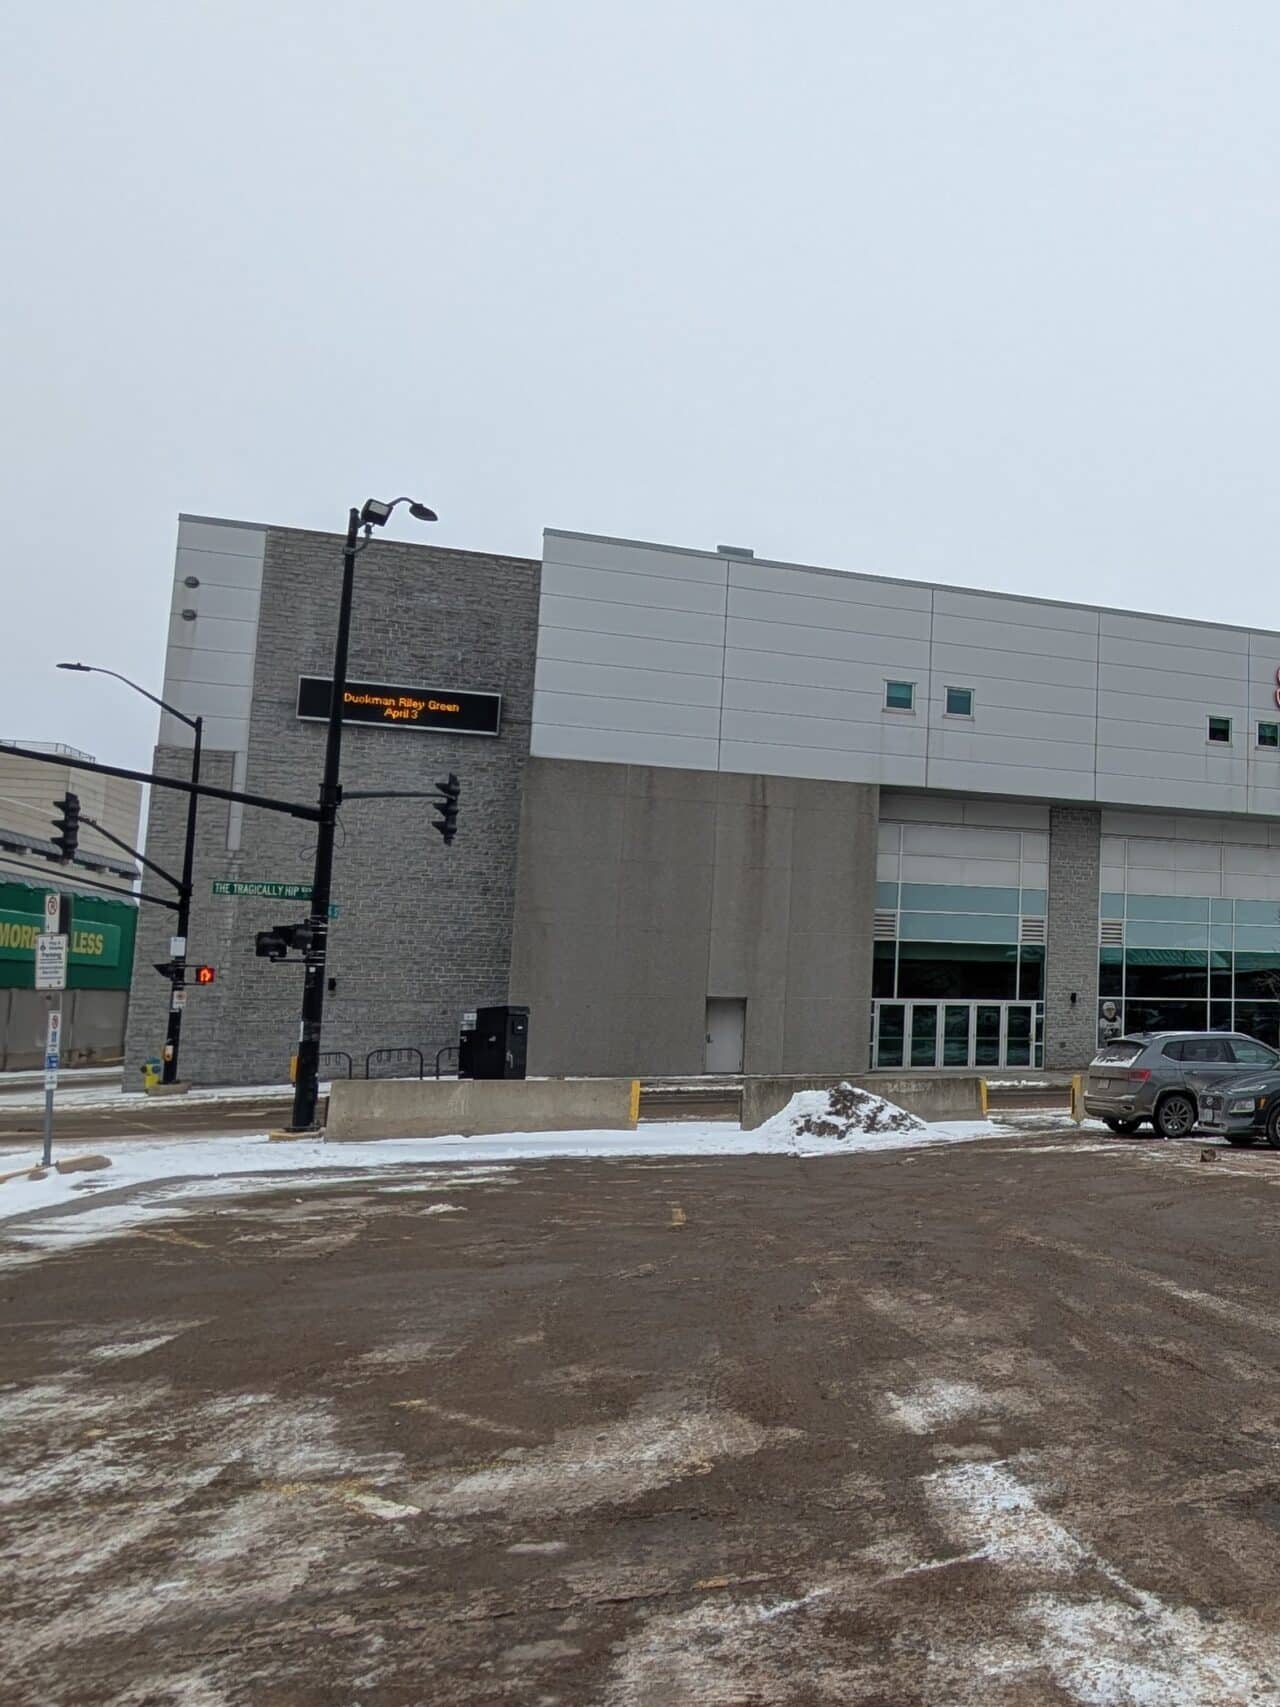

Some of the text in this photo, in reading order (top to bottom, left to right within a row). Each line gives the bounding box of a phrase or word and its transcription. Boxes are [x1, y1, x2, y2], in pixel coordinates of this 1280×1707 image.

[384, 707, 418, 719] April 3
[215, 883, 230, 893] THE
[233, 884, 282, 895] TRAGICALLY
[285, 887, 299, 896] HIP
[73, 931, 104, 954] LESS
